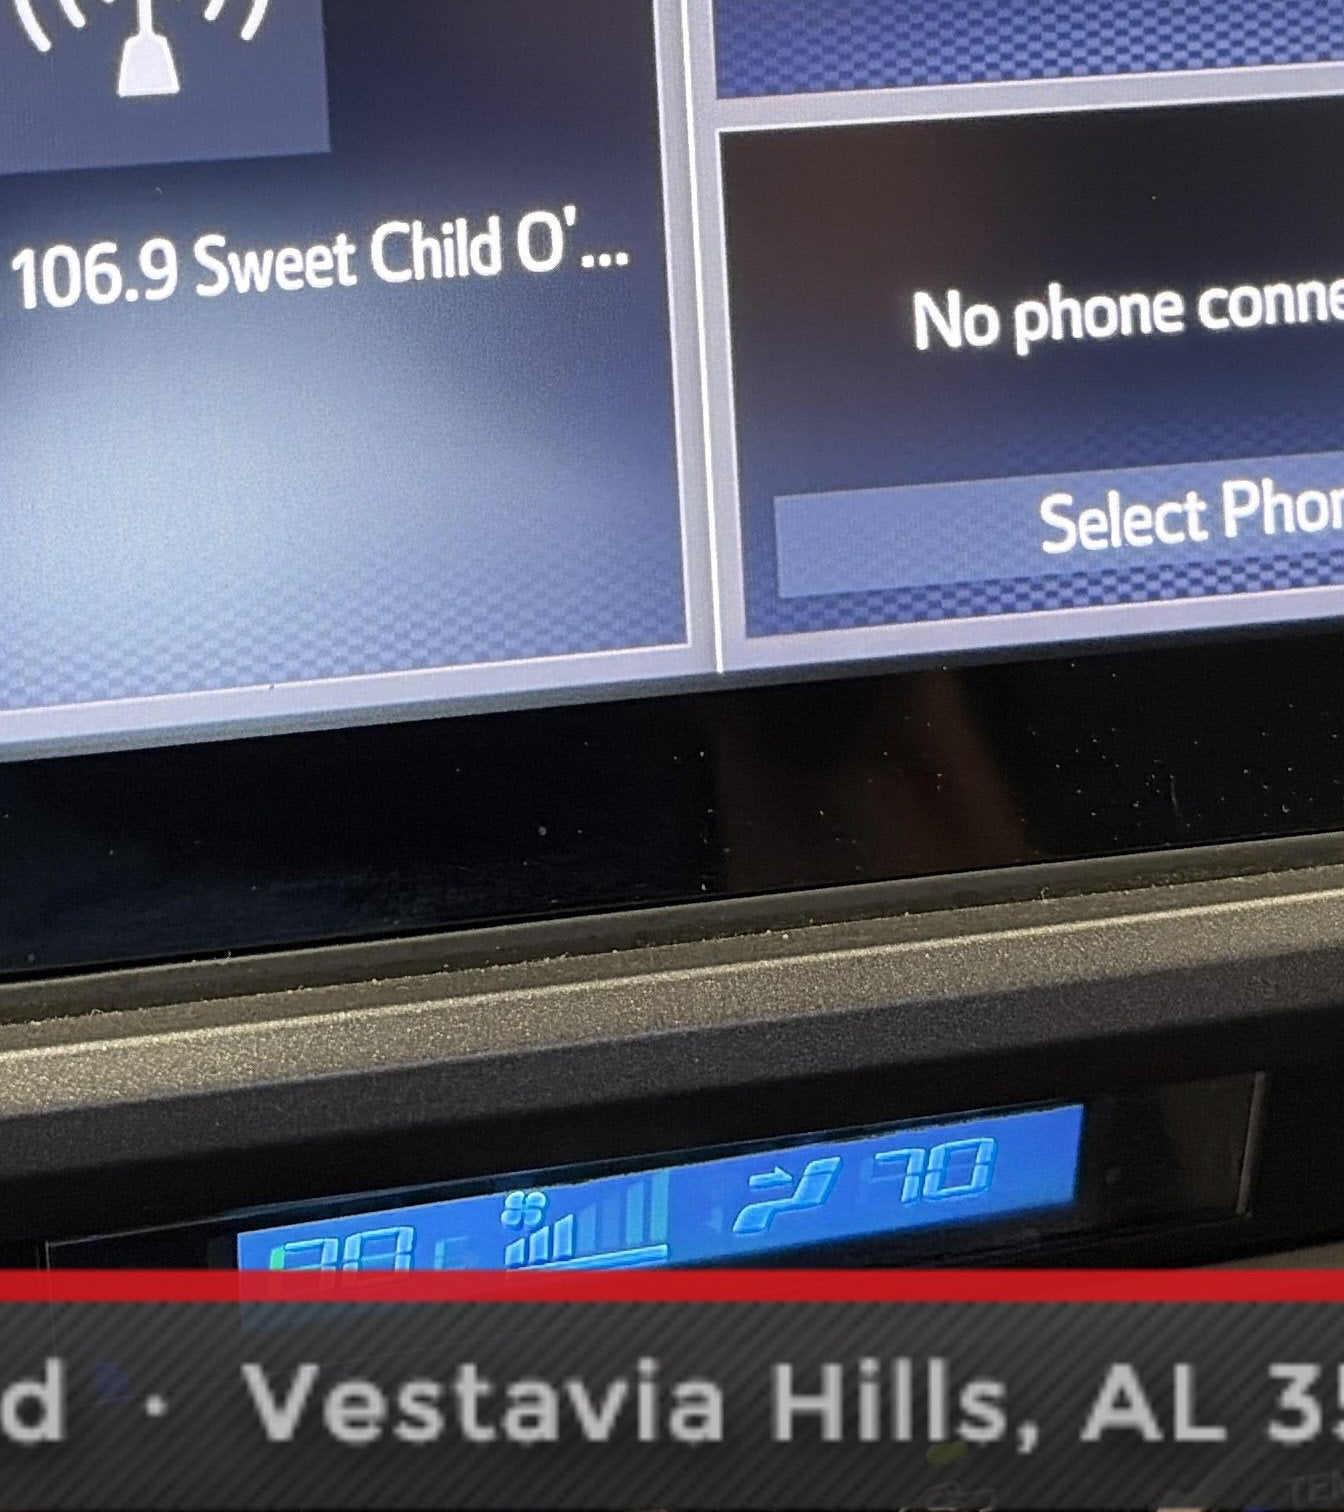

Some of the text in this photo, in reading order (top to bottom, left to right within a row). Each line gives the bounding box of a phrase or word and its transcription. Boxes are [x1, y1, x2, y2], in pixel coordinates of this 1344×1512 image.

[10, 238, 179, 310] 106.9
[193, 231, 358, 299] Sweet
[369, 215, 502, 285] Child
[912, 289, 999, 351] No
[1014, 282, 1184, 356] phone
[1038, 489, 1207, 555] Select
[874, 1135, 997, 1206] 70
